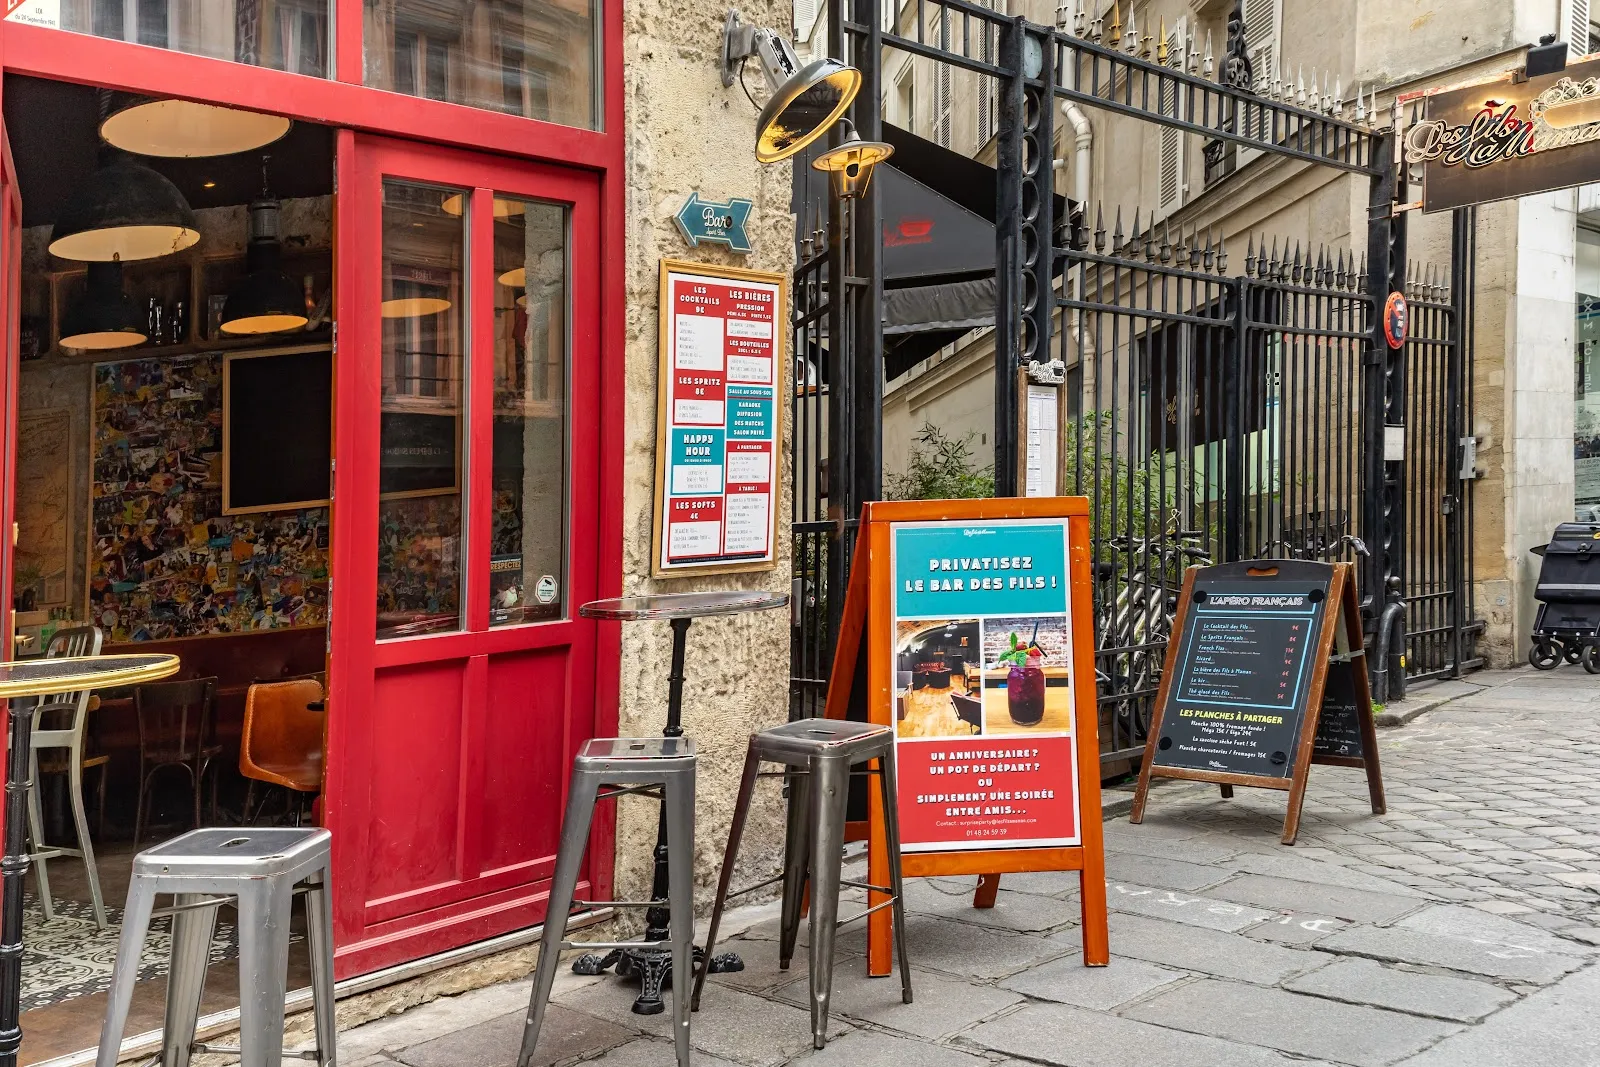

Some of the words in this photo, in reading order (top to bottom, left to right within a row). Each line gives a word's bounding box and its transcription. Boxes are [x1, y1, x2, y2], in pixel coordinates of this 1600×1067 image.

[27, 15, 47, 24] Septembre
[1404, 120, 1462, 162] Les
[1504, 122, 1600, 158] Mama
[702, 206, 728, 228] Bar
[694, 286, 707, 294] LES
[680, 295, 720, 305] COCKTAILS
[729, 290, 743, 299] LES
[744, 291, 771, 302] BIÈRES
[695, 306, 705, 314] 9€
[736, 303, 765, 311] PRESSION
[679, 377, 692, 385] LES
[694, 377, 721, 386] SPRITZ
[683, 434, 714, 444] HAPPY
[686, 447, 711, 456] HOUR
[676, 502, 690, 510] LES
[691, 501, 716, 509] SOFTS
[929, 556, 1033, 572] PRIVATISEZ
[905, 579, 924, 592] LE
[930, 578, 965, 592] BAR
[970, 577, 1003, 591] DES
[1009, 576, 1046, 590] FILS
[1051, 576, 1057, 588] !
[1209, 595, 1250, 605] L'APÉRO
[1251, 596, 1304, 607] FRANÇAIS
[1179, 709, 1194, 717] LES
[1194, 710, 1235, 720] PLANCHES
[1236, 711, 1242, 720] À
[1243, 714, 1283, 724] PARTAGER
[1225, 723, 1247, 731] fromage
[930, 752, 946, 761] UN
[949, 749, 1030, 760] ANNIVERSAIRE
[1032, 749, 1039, 757] ?
[1197, 747, 1228, 755] charcuteries
[1233, 750, 1256, 758] fromages
[929, 766, 945, 775] UN
[947, 765, 969, 774] POT
[972, 764, 987, 773] DE
[989, 762, 1032, 773] DÉPART
[1034, 763, 1041, 771] ?
[977, 778, 993, 787] OU
[917, 792, 987, 804] SIMPLEMENT
[989, 791, 1011, 801] UNE
[1014, 789, 1055, 800] SOIRÉE
[945, 806, 981, 817] ENTRE
[984, 805, 1027, 816] AMIS...
